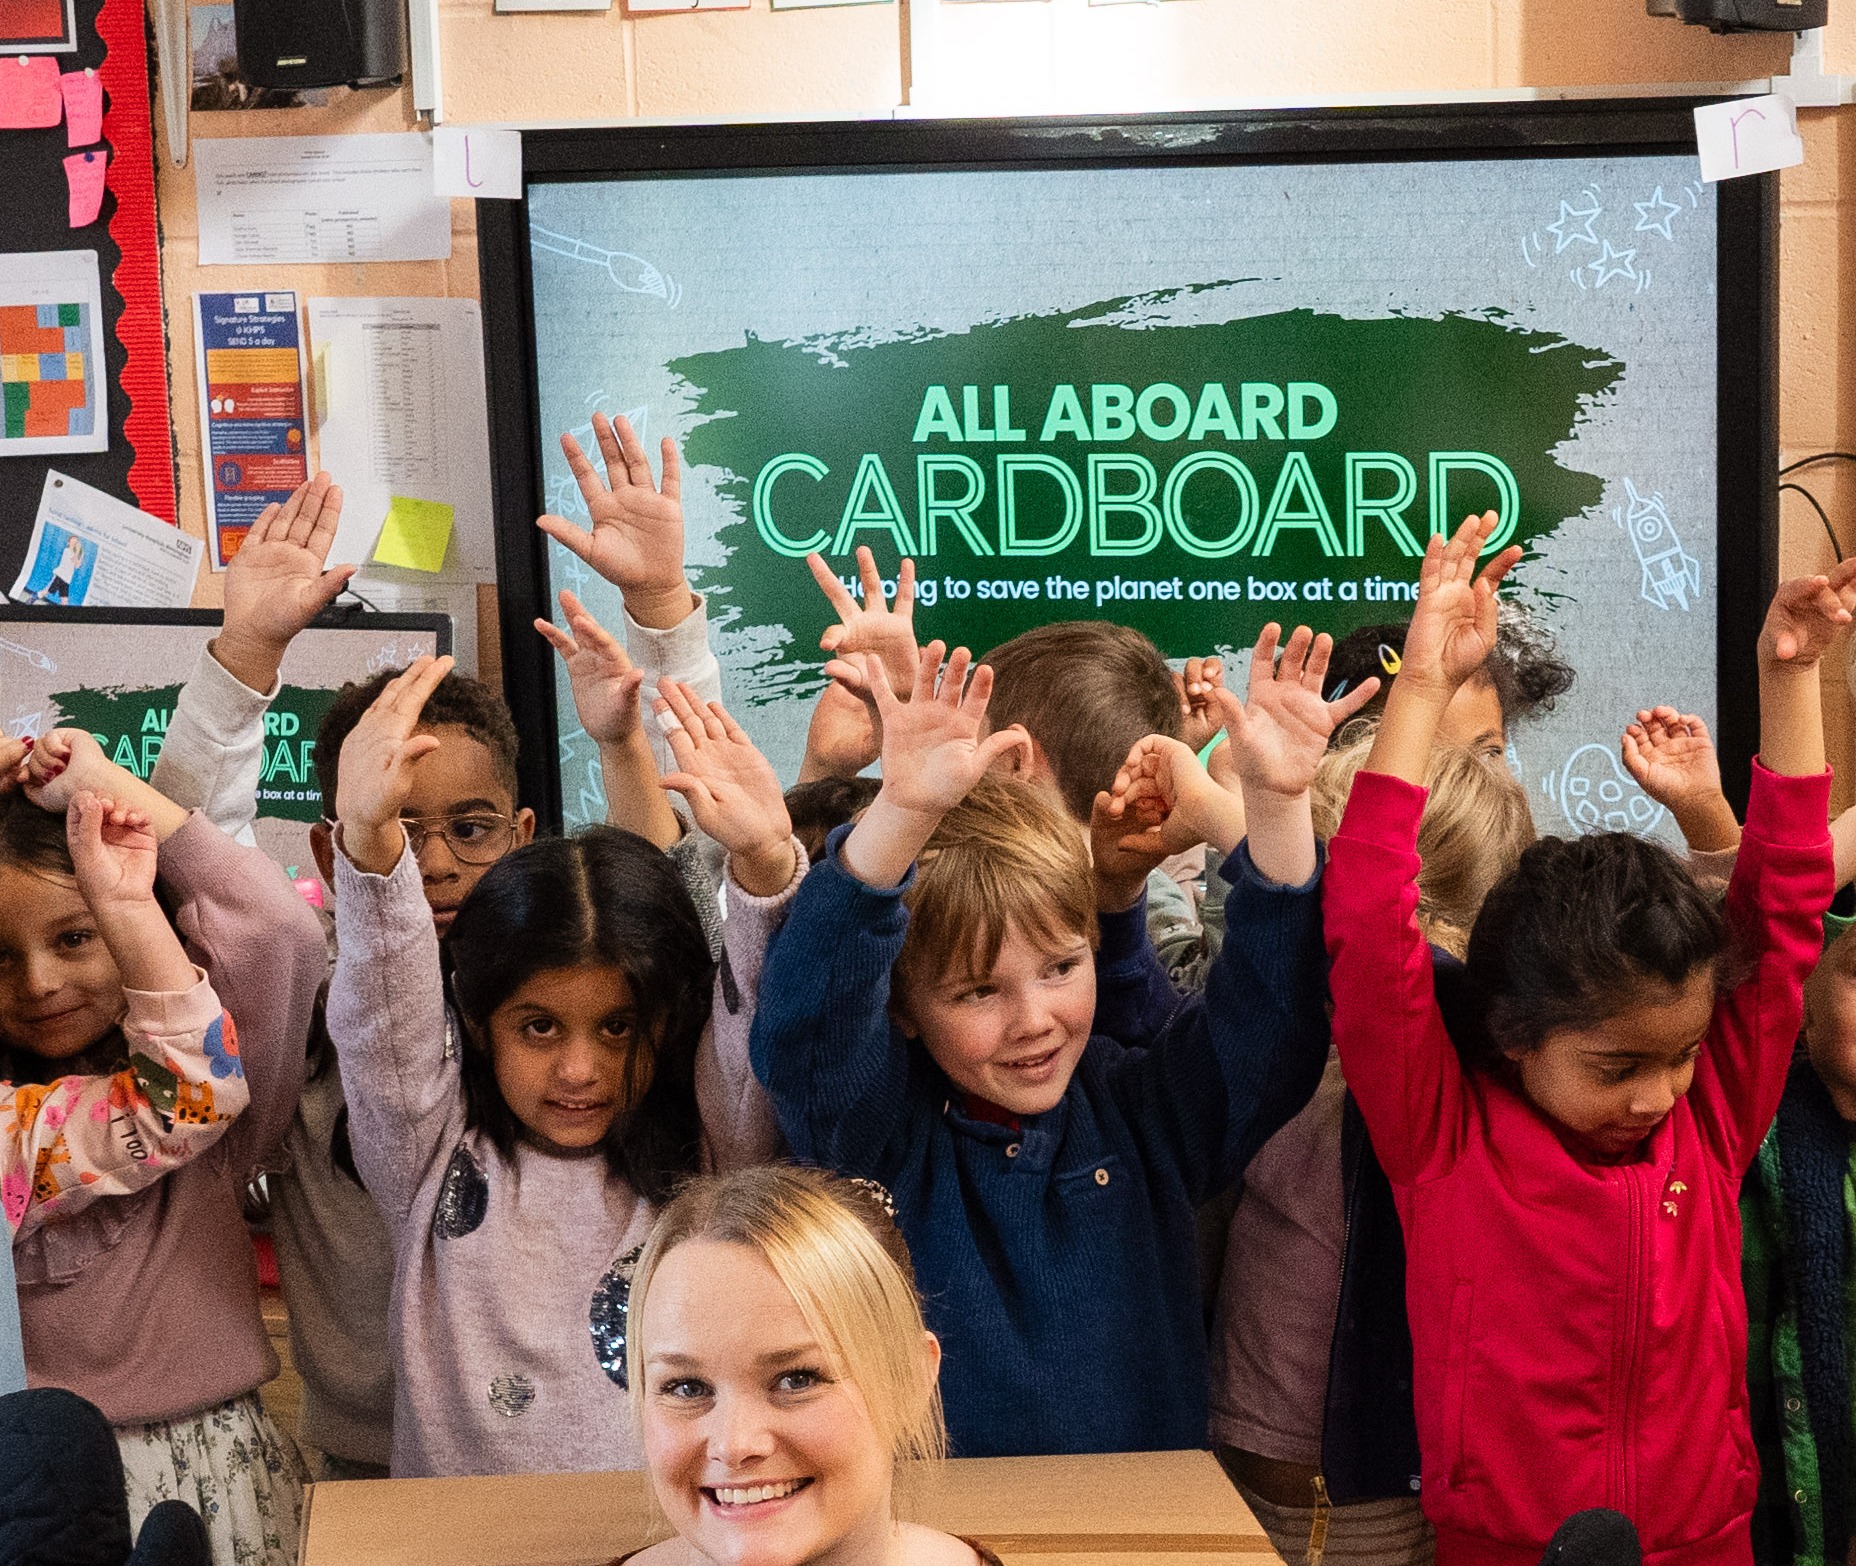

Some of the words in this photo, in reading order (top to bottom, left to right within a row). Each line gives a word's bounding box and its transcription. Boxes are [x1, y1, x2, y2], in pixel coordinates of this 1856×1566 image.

[912, 385, 1026, 442] ALL
[1040, 382, 1338, 442] ABOARD
[752, 450, 1520, 559] CARDBOARD
[943, 576, 971, 599] to
[976, 580, 1039, 600] save
[1045, 576, 1090, 600] the
[1096, 576, 1183, 607] planet
[1188, 580, 1241, 601] one
[1248, 576, 1297, 601] box
[1304, 578, 1333, 601] at
[1338, 582, 1357, 601] a
[263, 788, 282, 800] box
[284, 789, 295, 800] at
